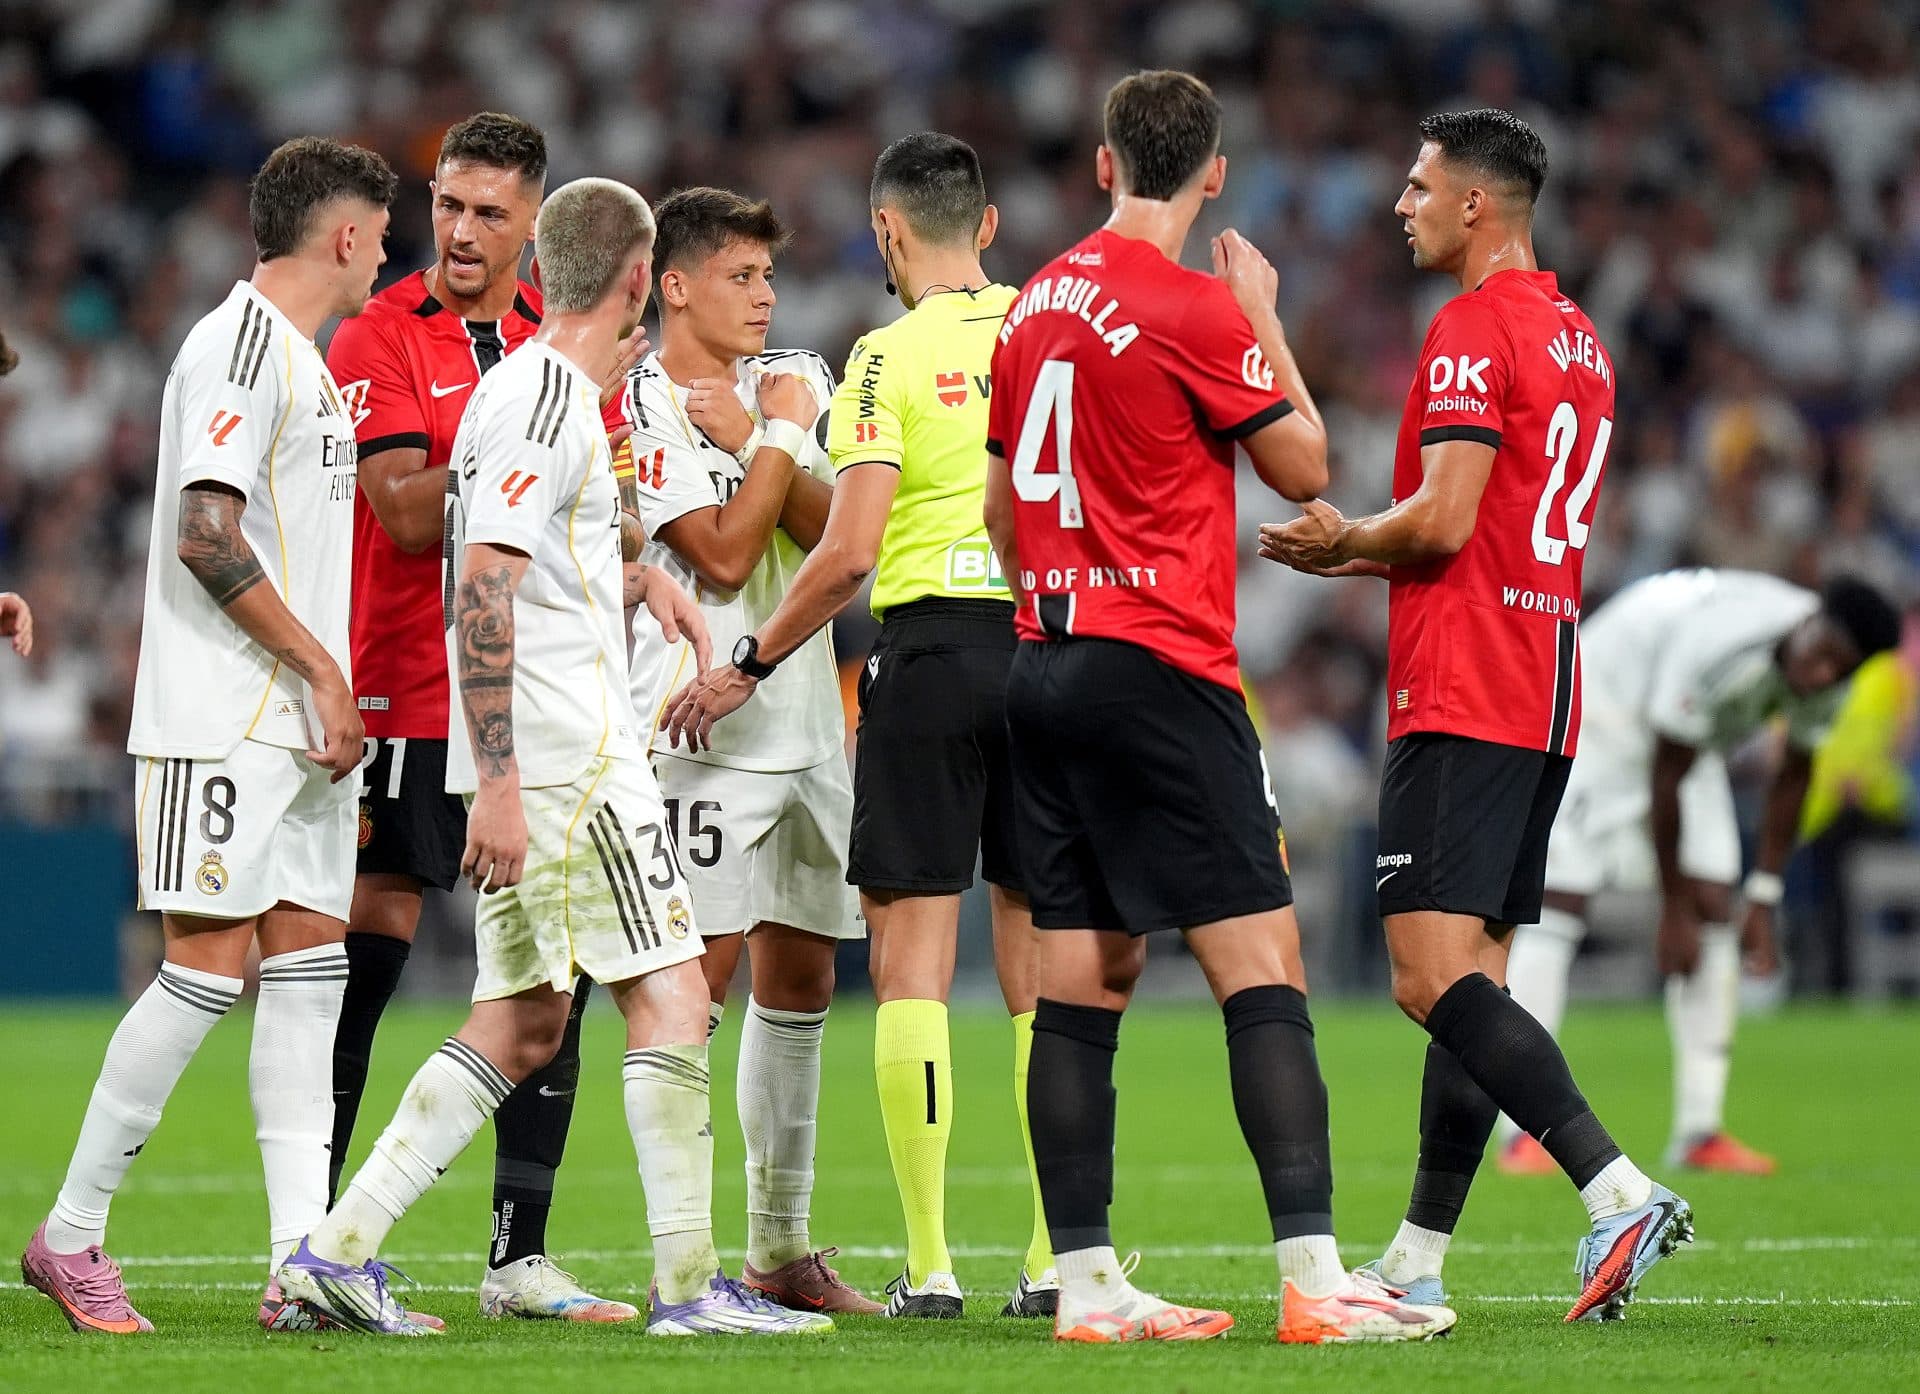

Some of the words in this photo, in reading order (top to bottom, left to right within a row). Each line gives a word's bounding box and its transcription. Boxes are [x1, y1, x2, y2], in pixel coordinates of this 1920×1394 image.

[1429, 355, 1491, 393] OK
[1012, 359, 1084, 529] 4
[1531, 401, 1613, 565] 24
[1046, 567, 1078, 590] OF
[1088, 566, 1158, 588] HYATT
[1503, 586, 1560, 615] WORLD
[199, 776, 237, 845] 8
